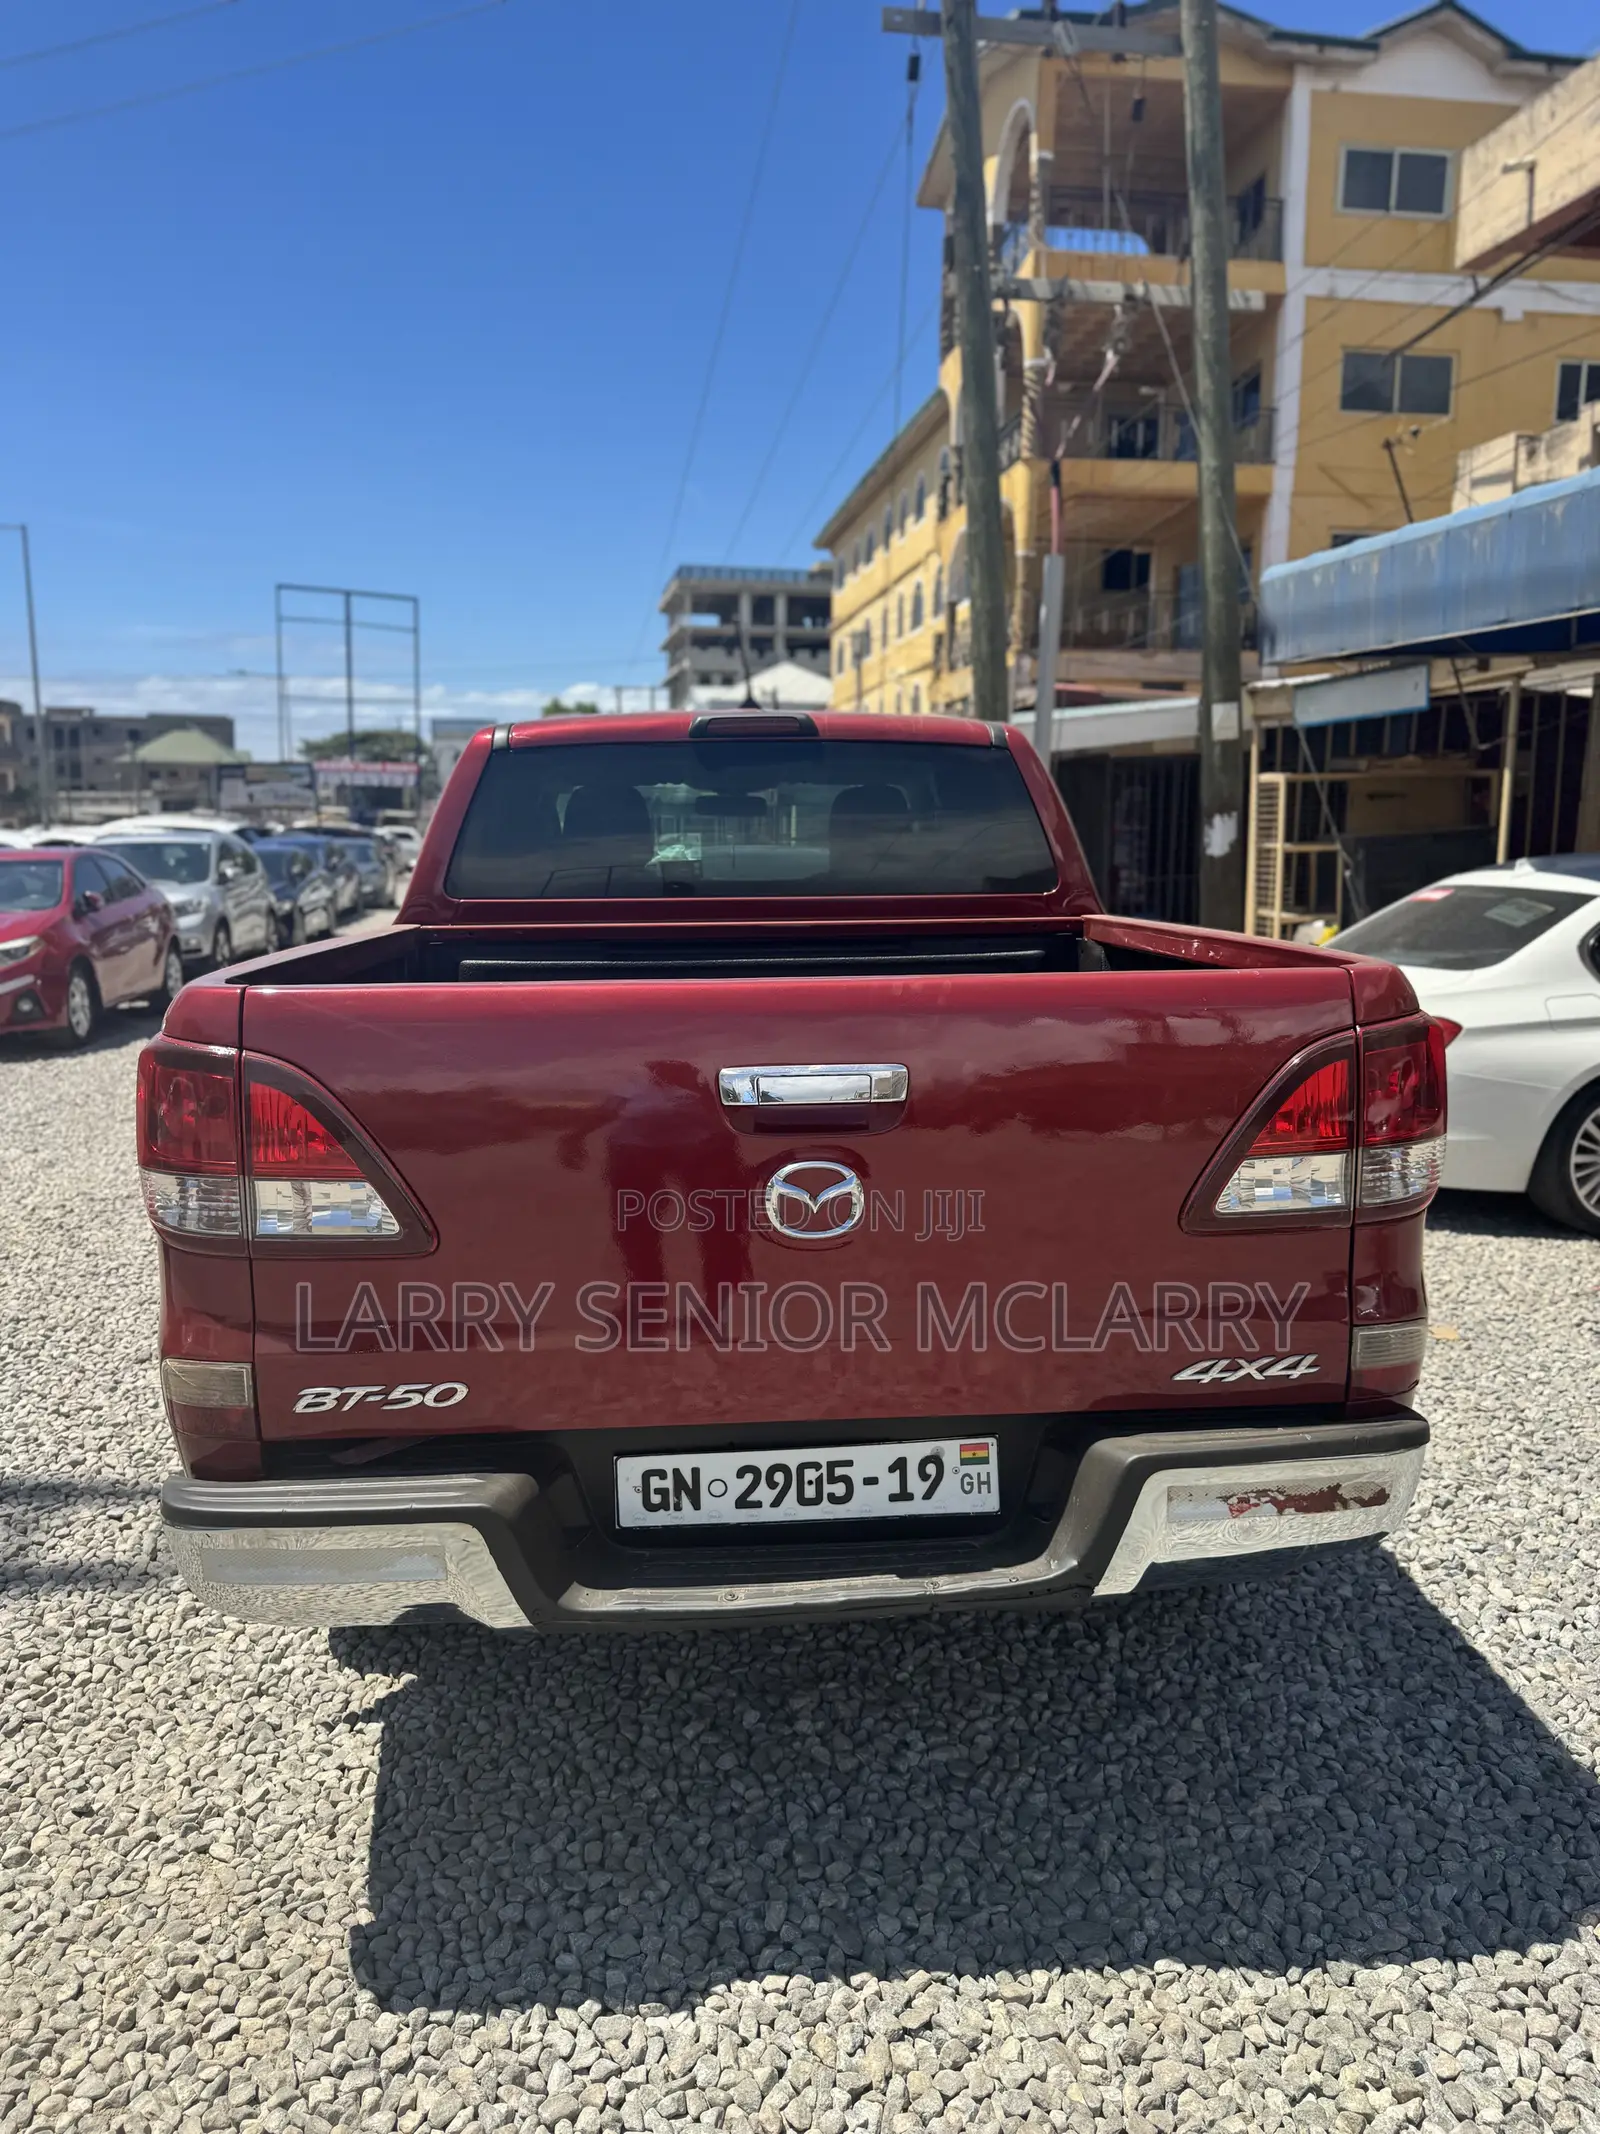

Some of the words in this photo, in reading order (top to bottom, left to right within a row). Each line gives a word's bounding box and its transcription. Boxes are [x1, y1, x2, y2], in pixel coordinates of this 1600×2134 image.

[293, 1382, 469, 1413] BT-50
[641, 1467, 701, 1512] GN
[960, 1472, 992, 1495] GH
